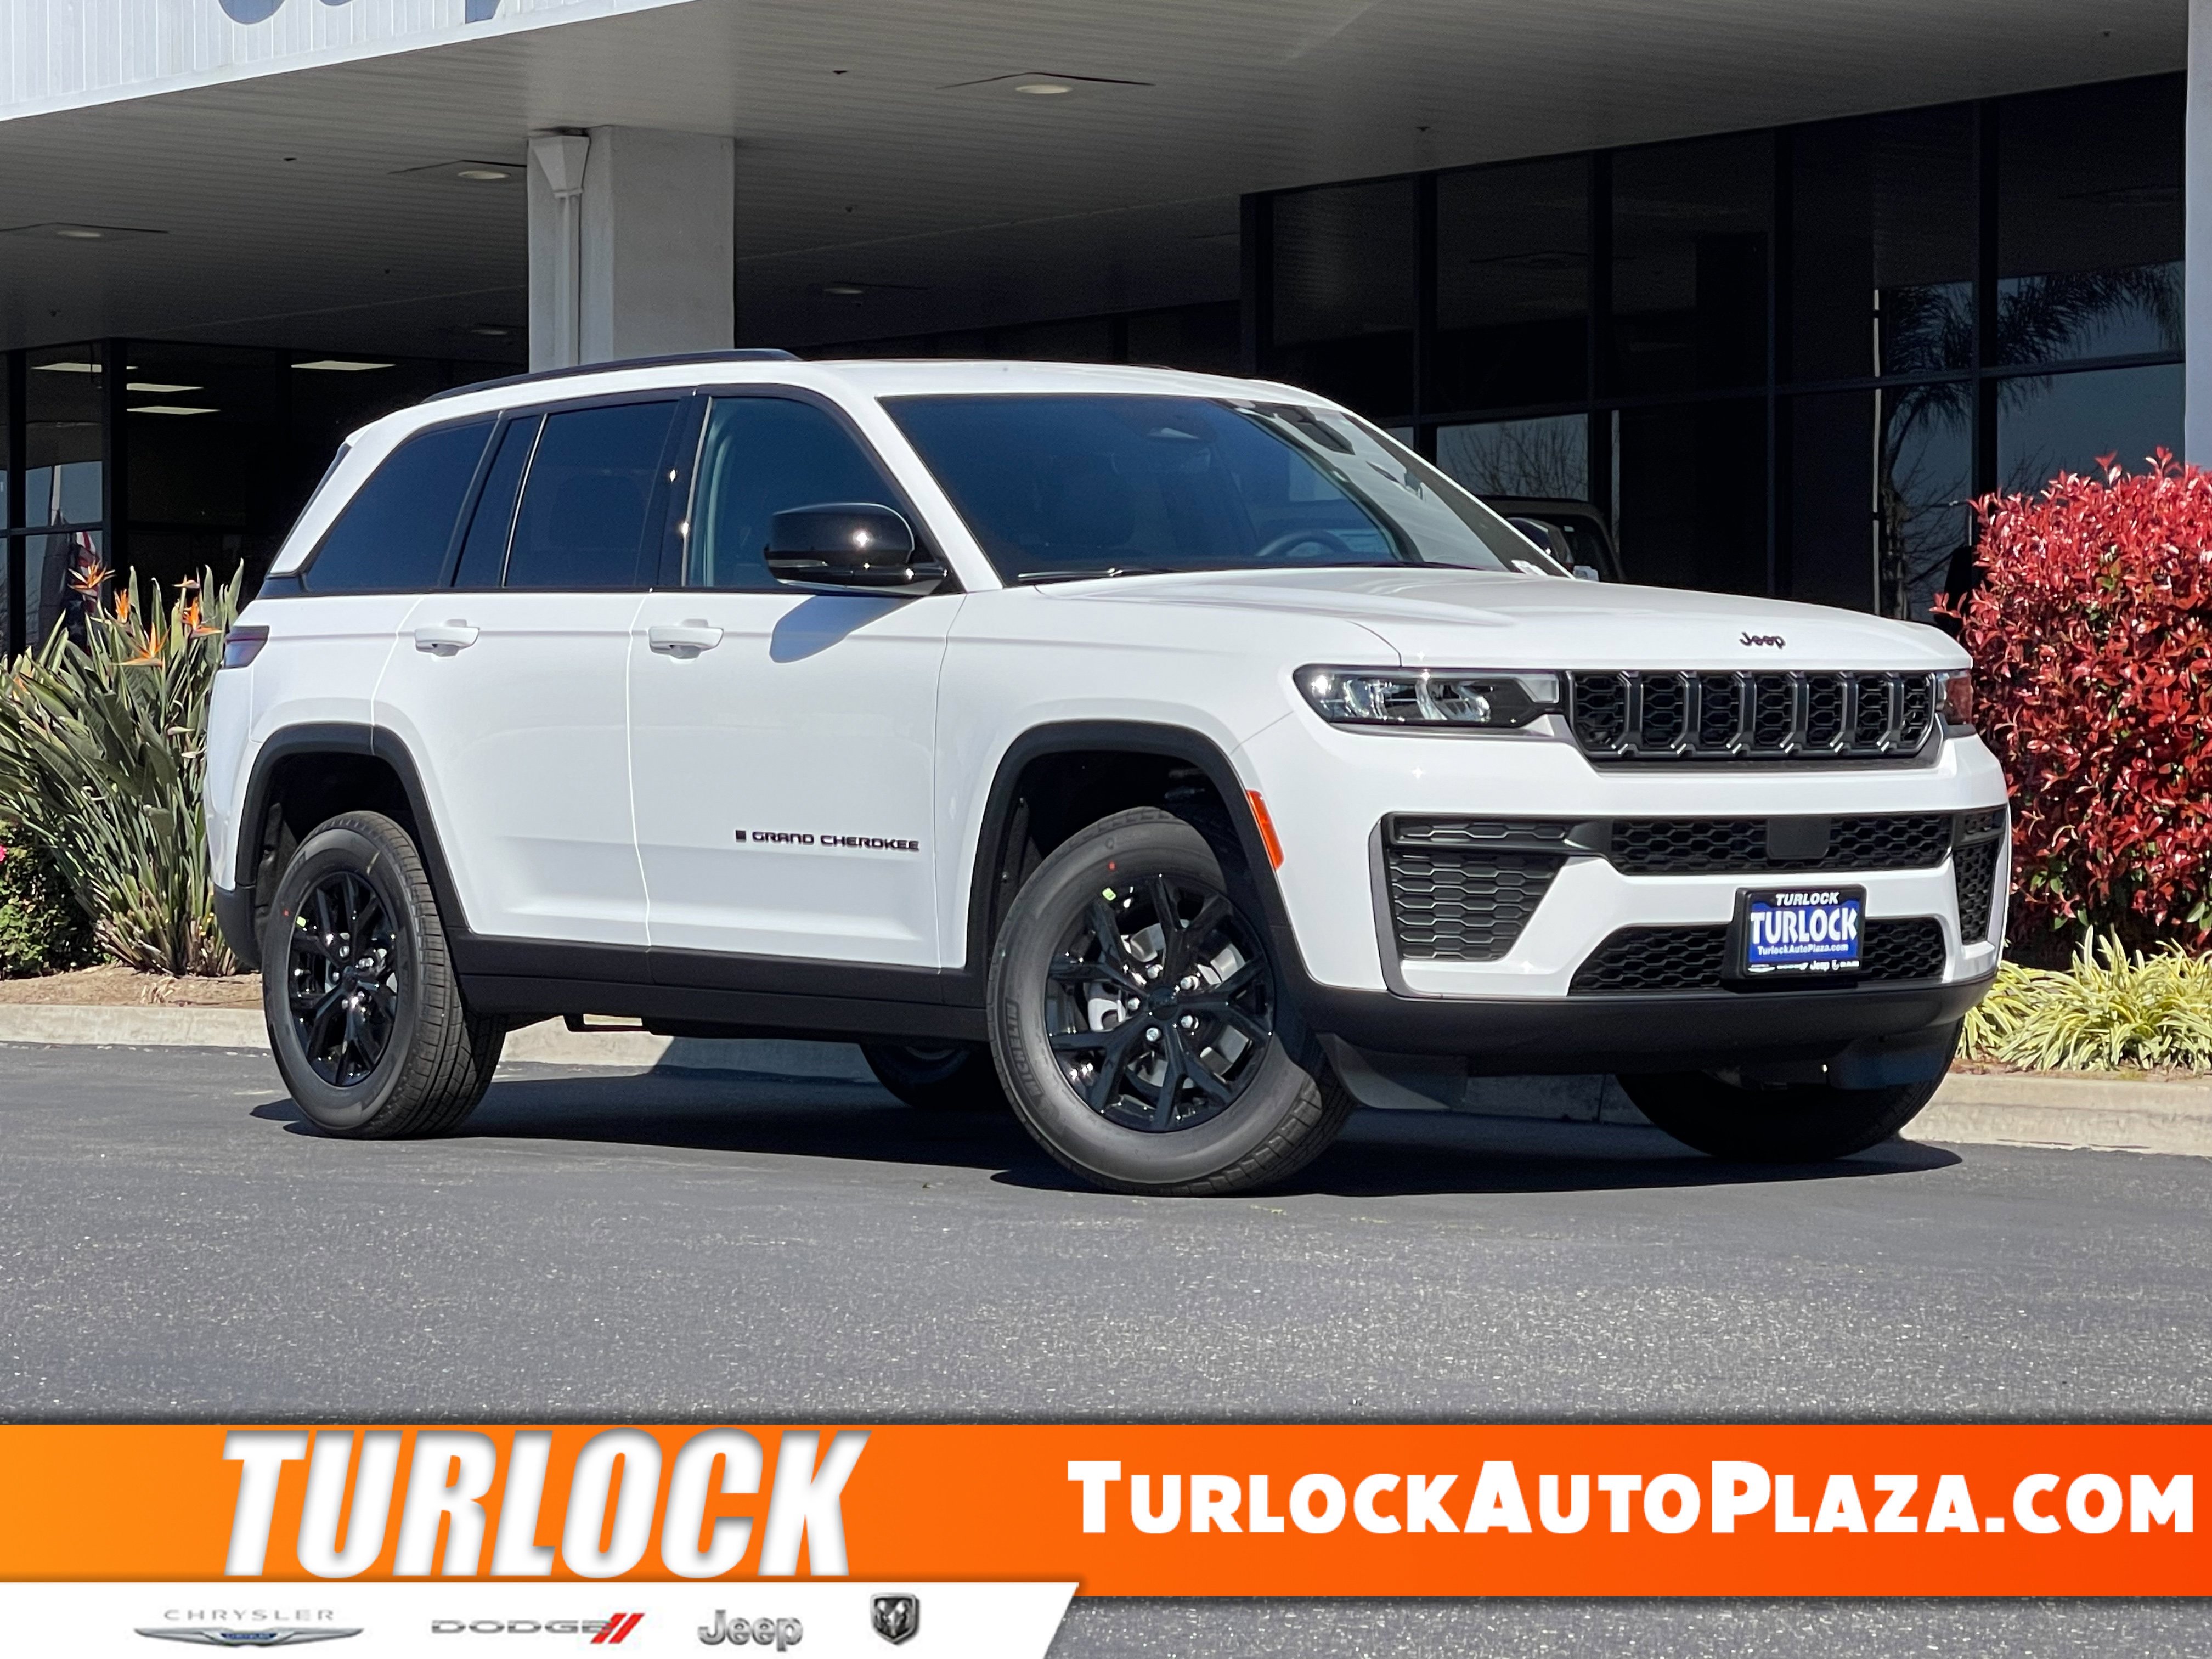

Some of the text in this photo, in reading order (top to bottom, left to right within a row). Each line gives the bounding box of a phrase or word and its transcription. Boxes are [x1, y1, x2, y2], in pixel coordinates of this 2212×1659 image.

[1739, 632, 1786, 650] Jeep
[752, 831, 919, 851] GRAND CHEROKEE
[1776, 891, 1839, 906] TURLOCK
[1750, 908, 1858, 944] TURLOCK
[1757, 944, 1849, 956] TurlockAutoPlaza.com
[1006, 1001, 1045, 1097] MICHELIN
